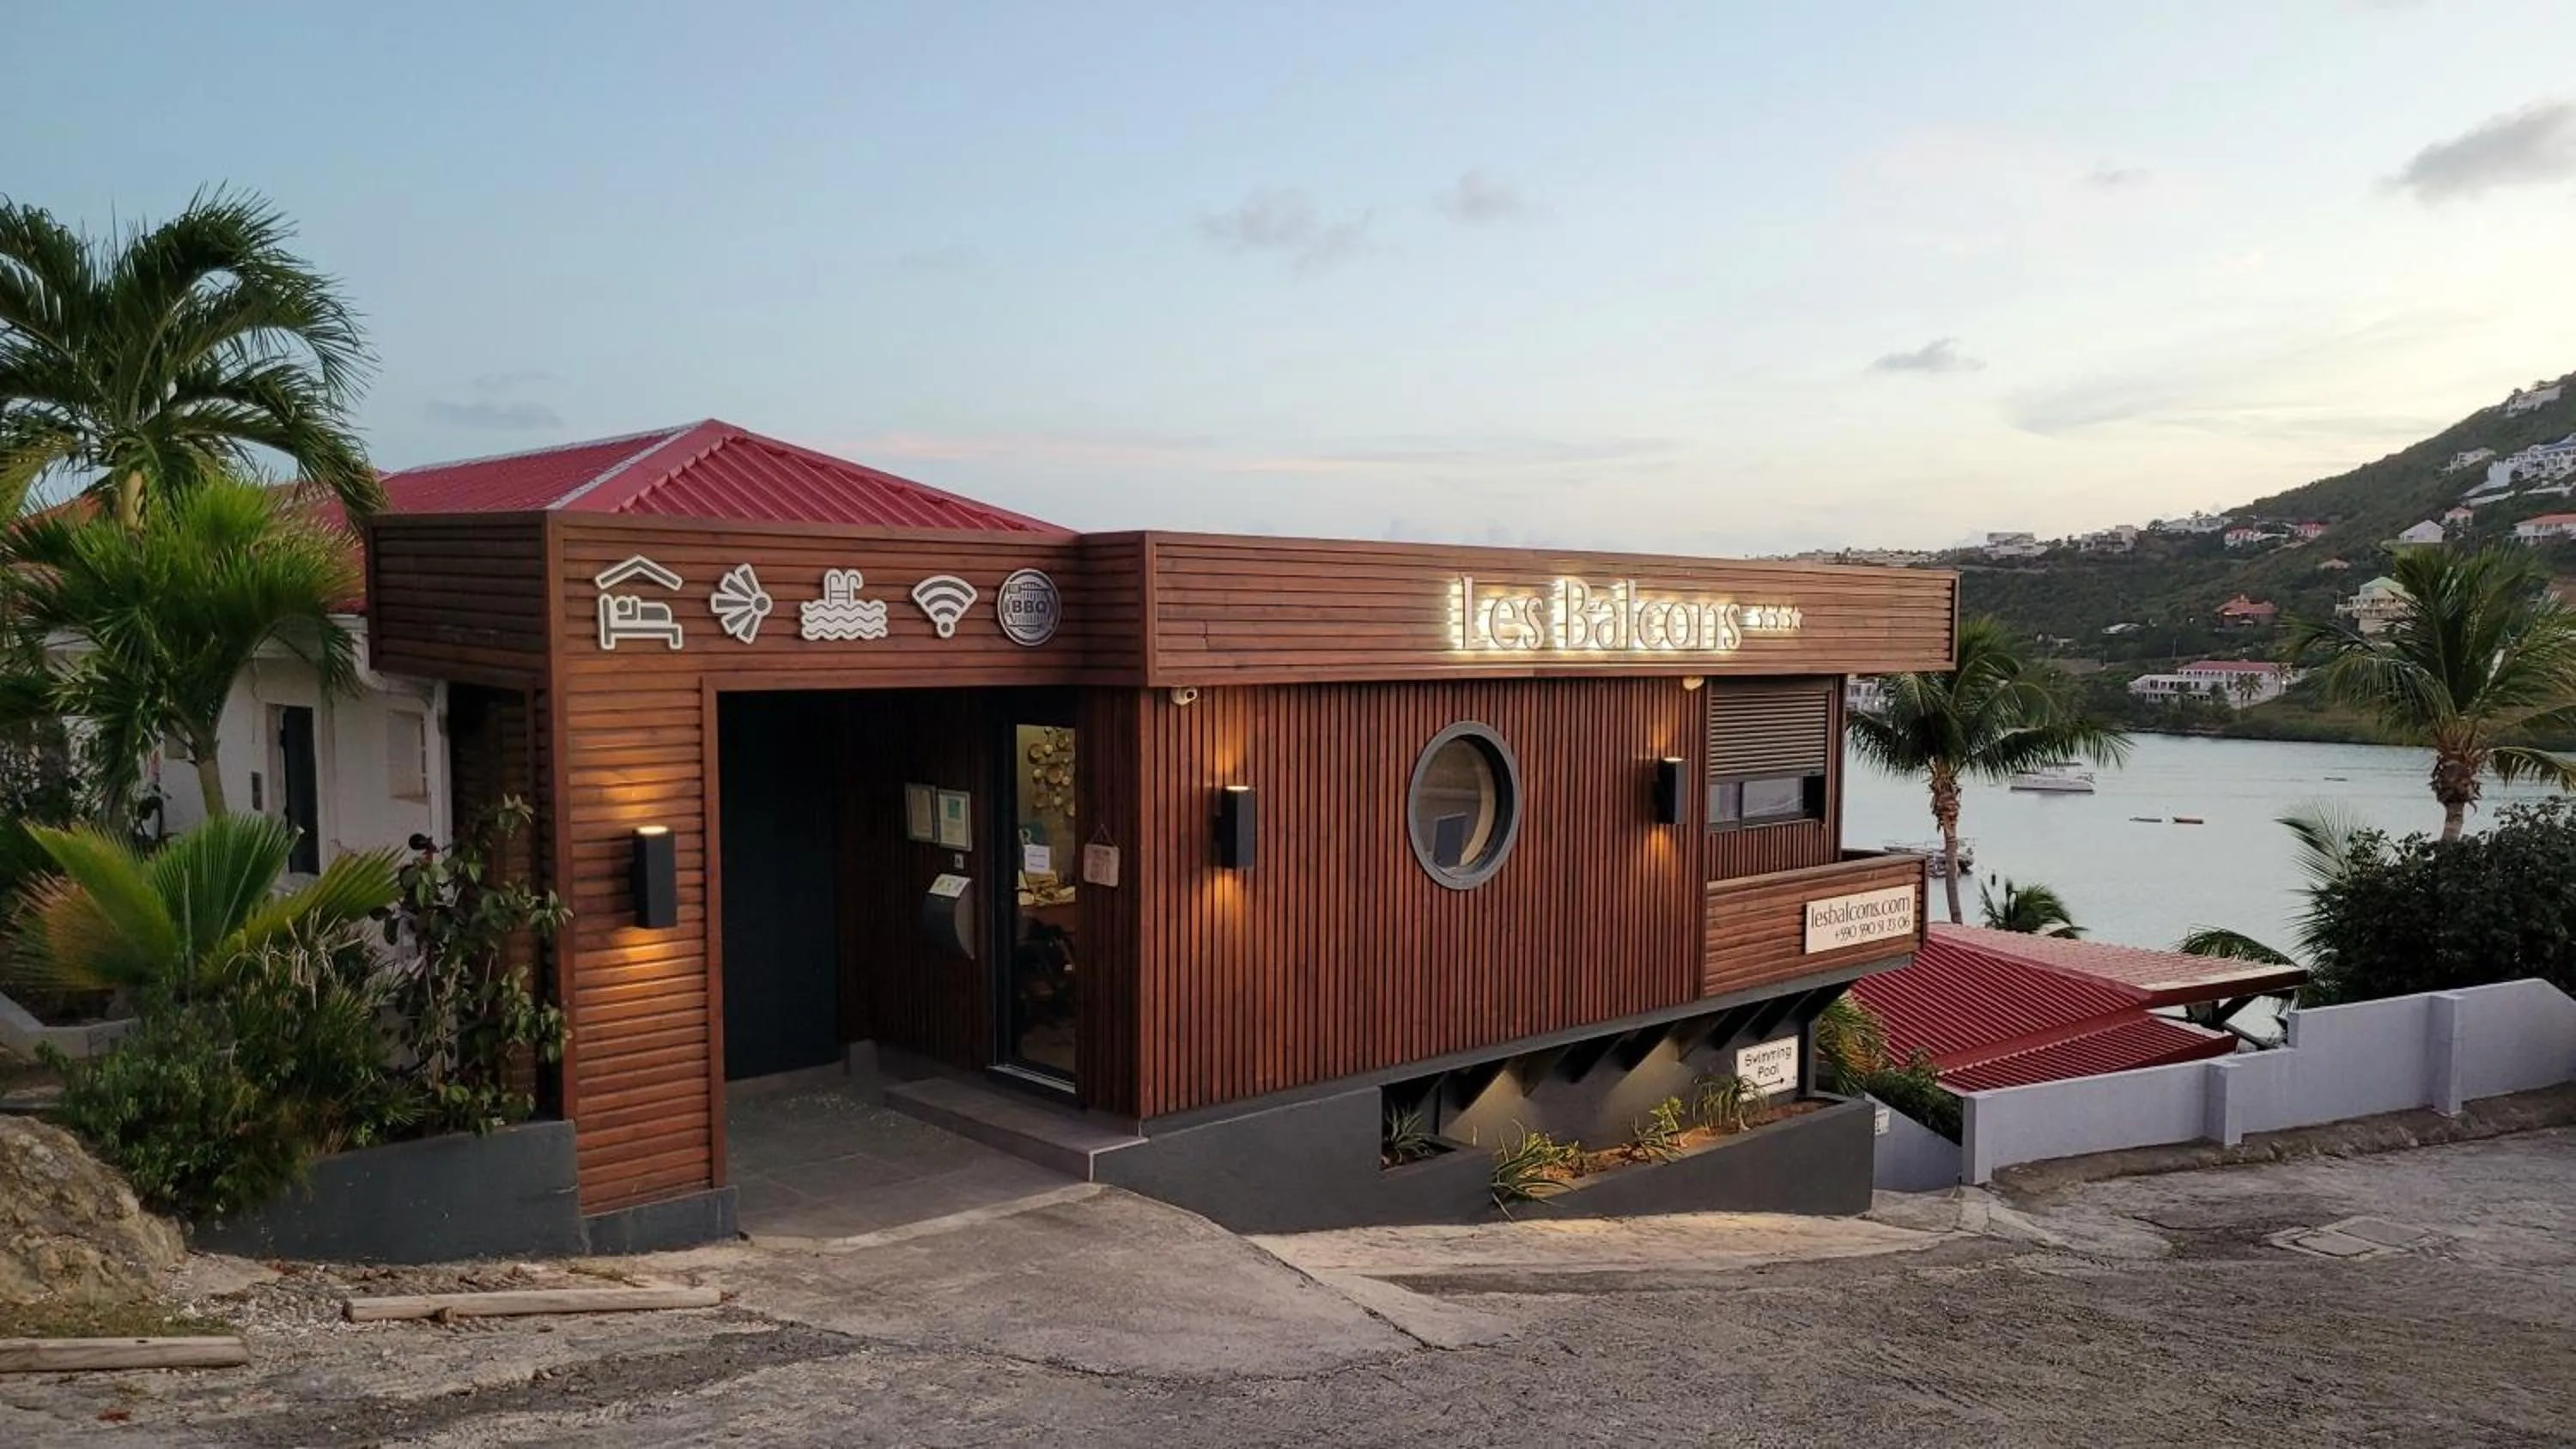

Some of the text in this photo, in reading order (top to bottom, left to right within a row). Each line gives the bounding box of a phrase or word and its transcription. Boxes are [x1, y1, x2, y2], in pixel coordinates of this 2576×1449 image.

[1012, 601, 1047, 613] BBQ
[1462, 577, 1742, 651] Les Balcons
[1811, 897, 1911, 927] lesbalcons.com
[1745, 1046, 1791, 1066] Swimming
[1758, 1064, 1779, 1078] Pool
